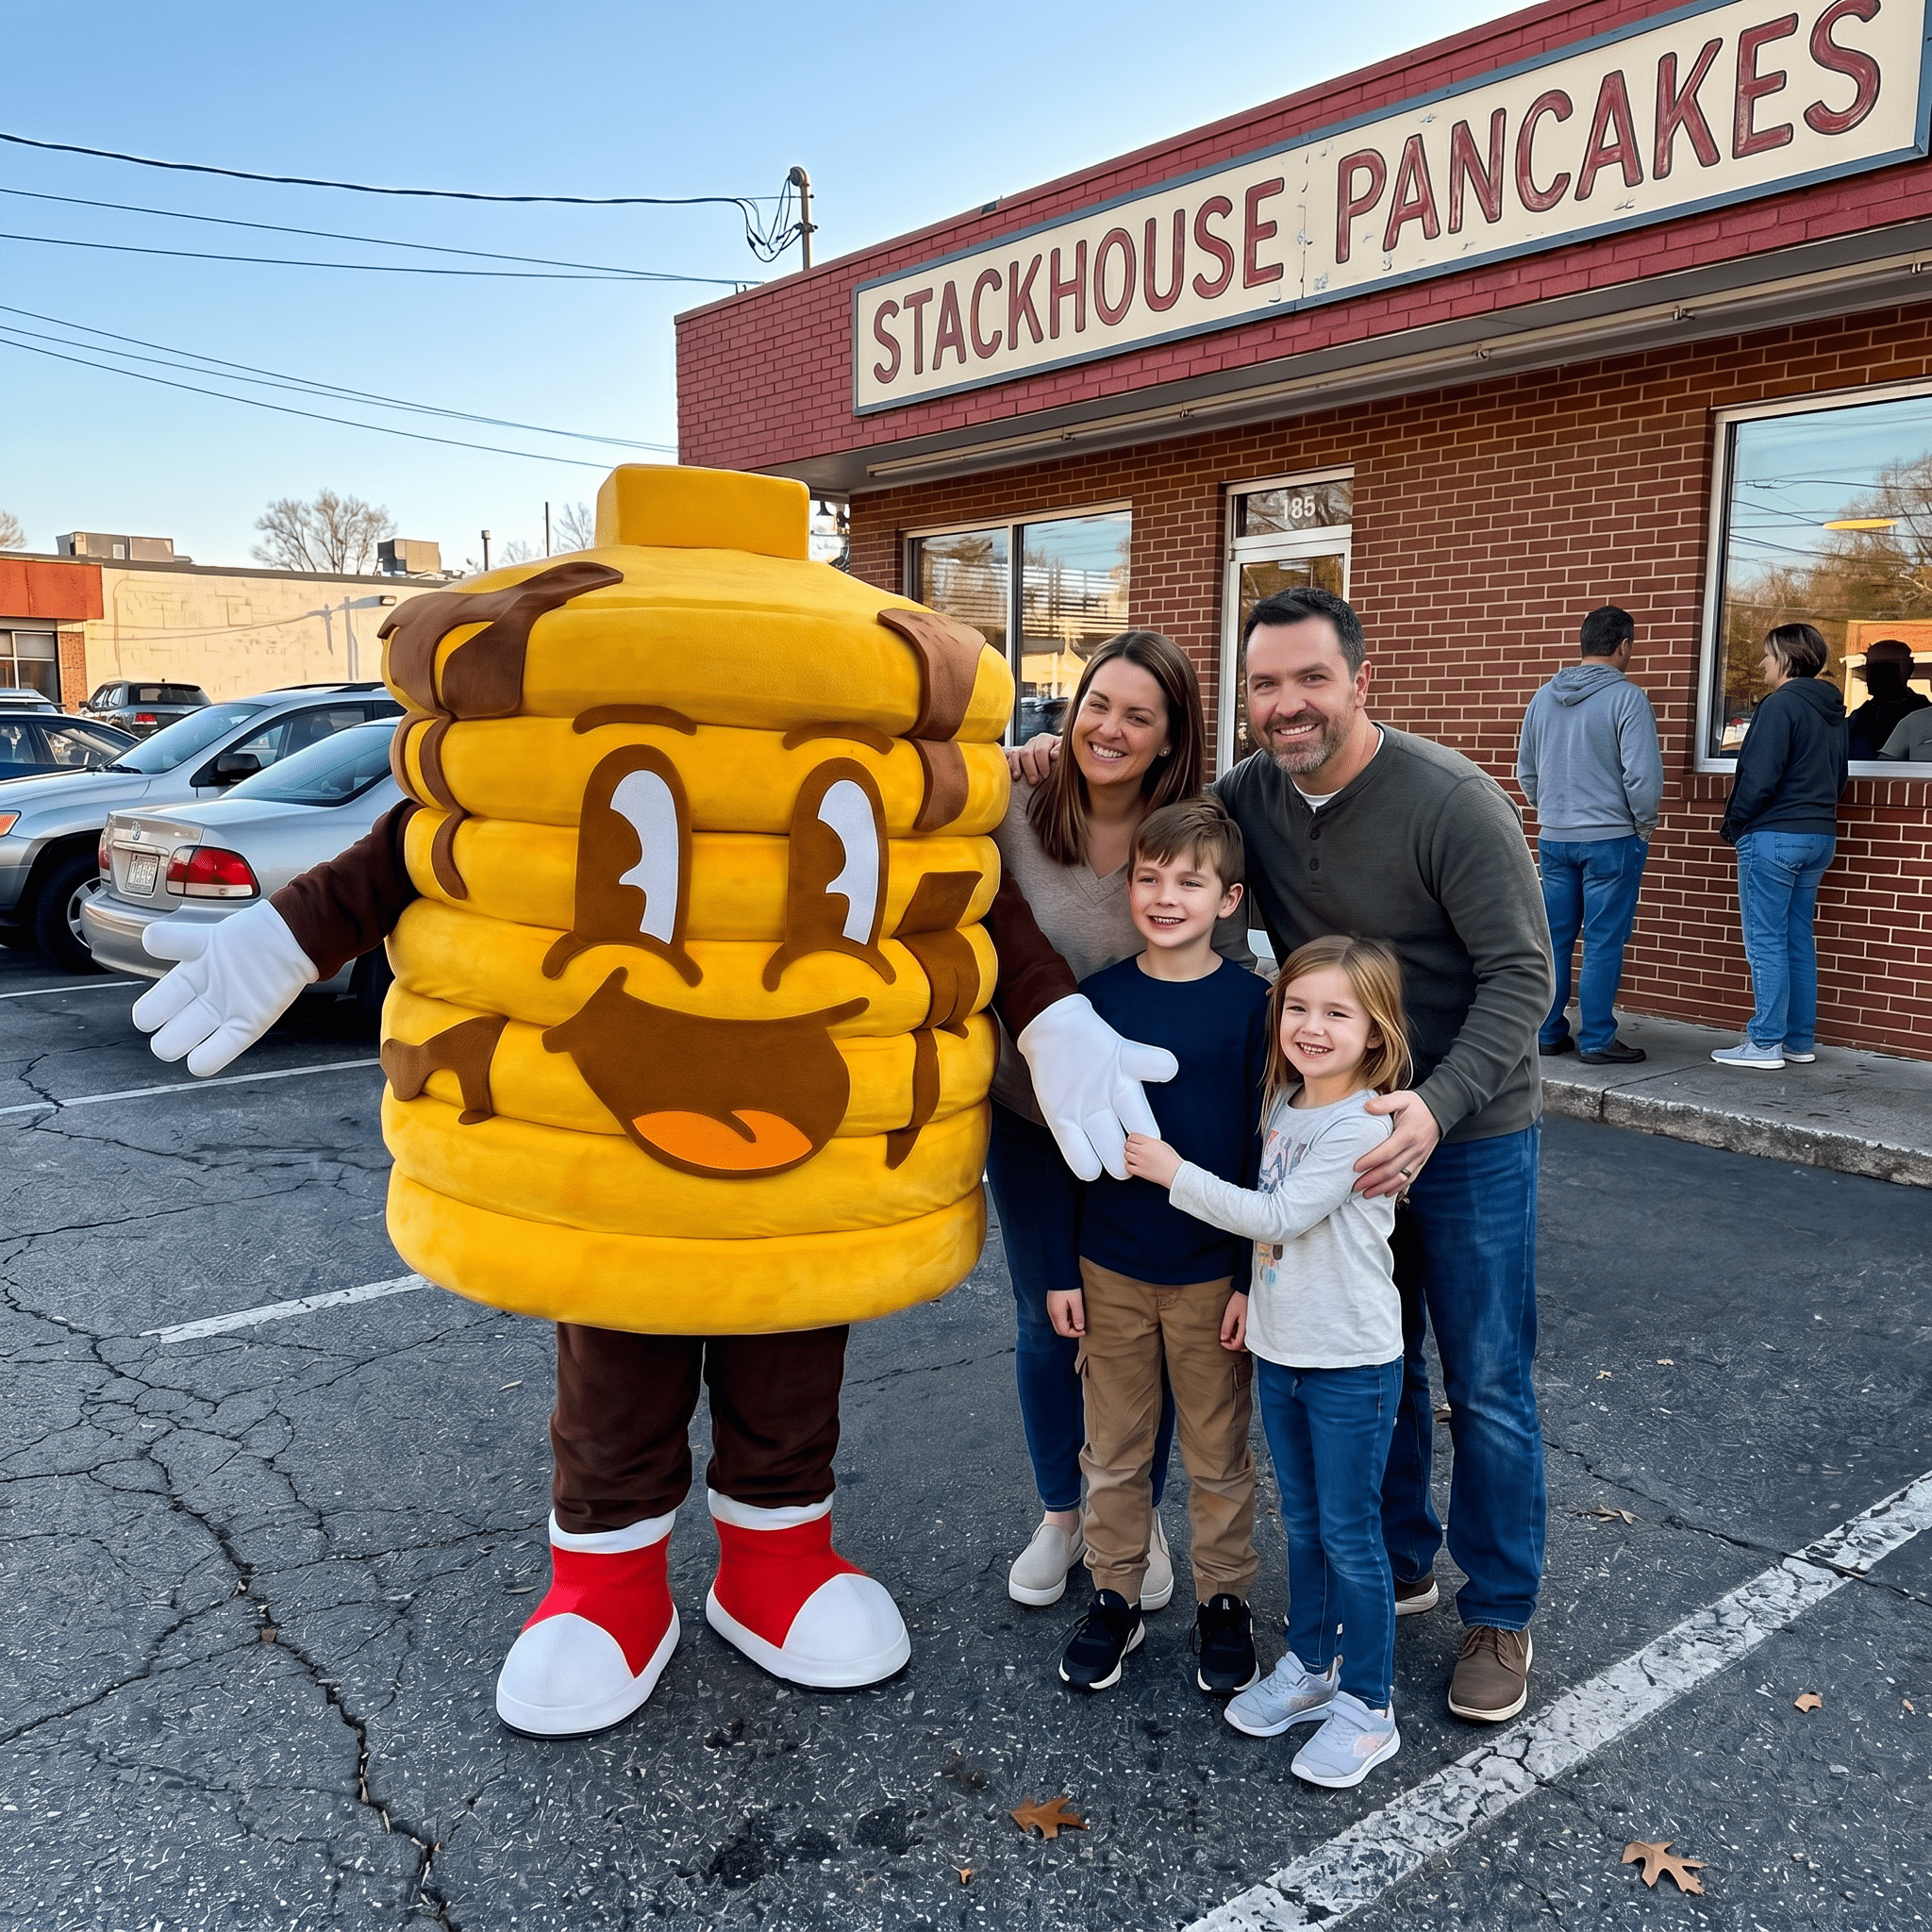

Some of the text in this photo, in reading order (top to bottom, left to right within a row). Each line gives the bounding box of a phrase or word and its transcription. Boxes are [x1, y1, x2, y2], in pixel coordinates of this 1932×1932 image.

[873, 0, 1882, 384] STACKHOUSE PANCAKES
[1282, 494, 1316, 521] 185
